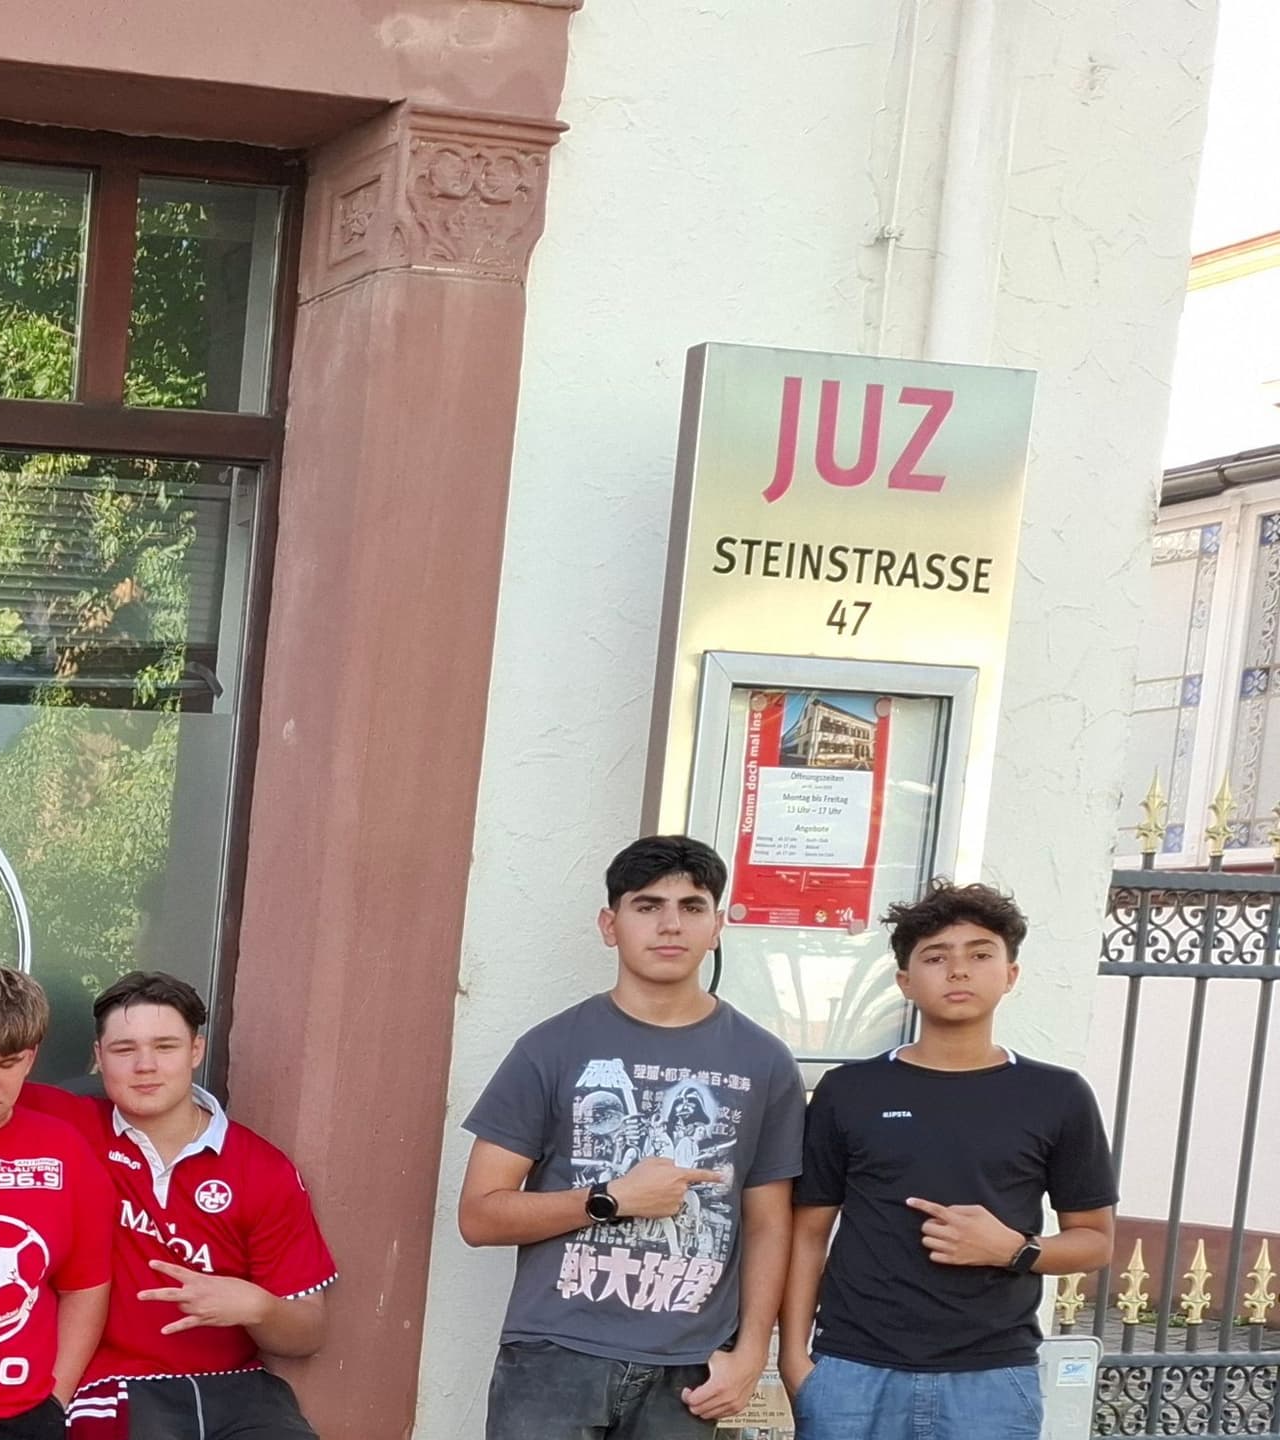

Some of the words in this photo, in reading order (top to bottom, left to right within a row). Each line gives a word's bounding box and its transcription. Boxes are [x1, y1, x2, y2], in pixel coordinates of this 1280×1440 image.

[761, 376, 954, 504] JUZ
[711, 535, 994, 595] STEINSTRASSE
[825, 598, 873, 636] 47
[754, 712, 763, 730] ins
[750, 731, 760, 756] mal
[746, 759, 757, 791] doch
[741, 793, 755, 833] Komm
